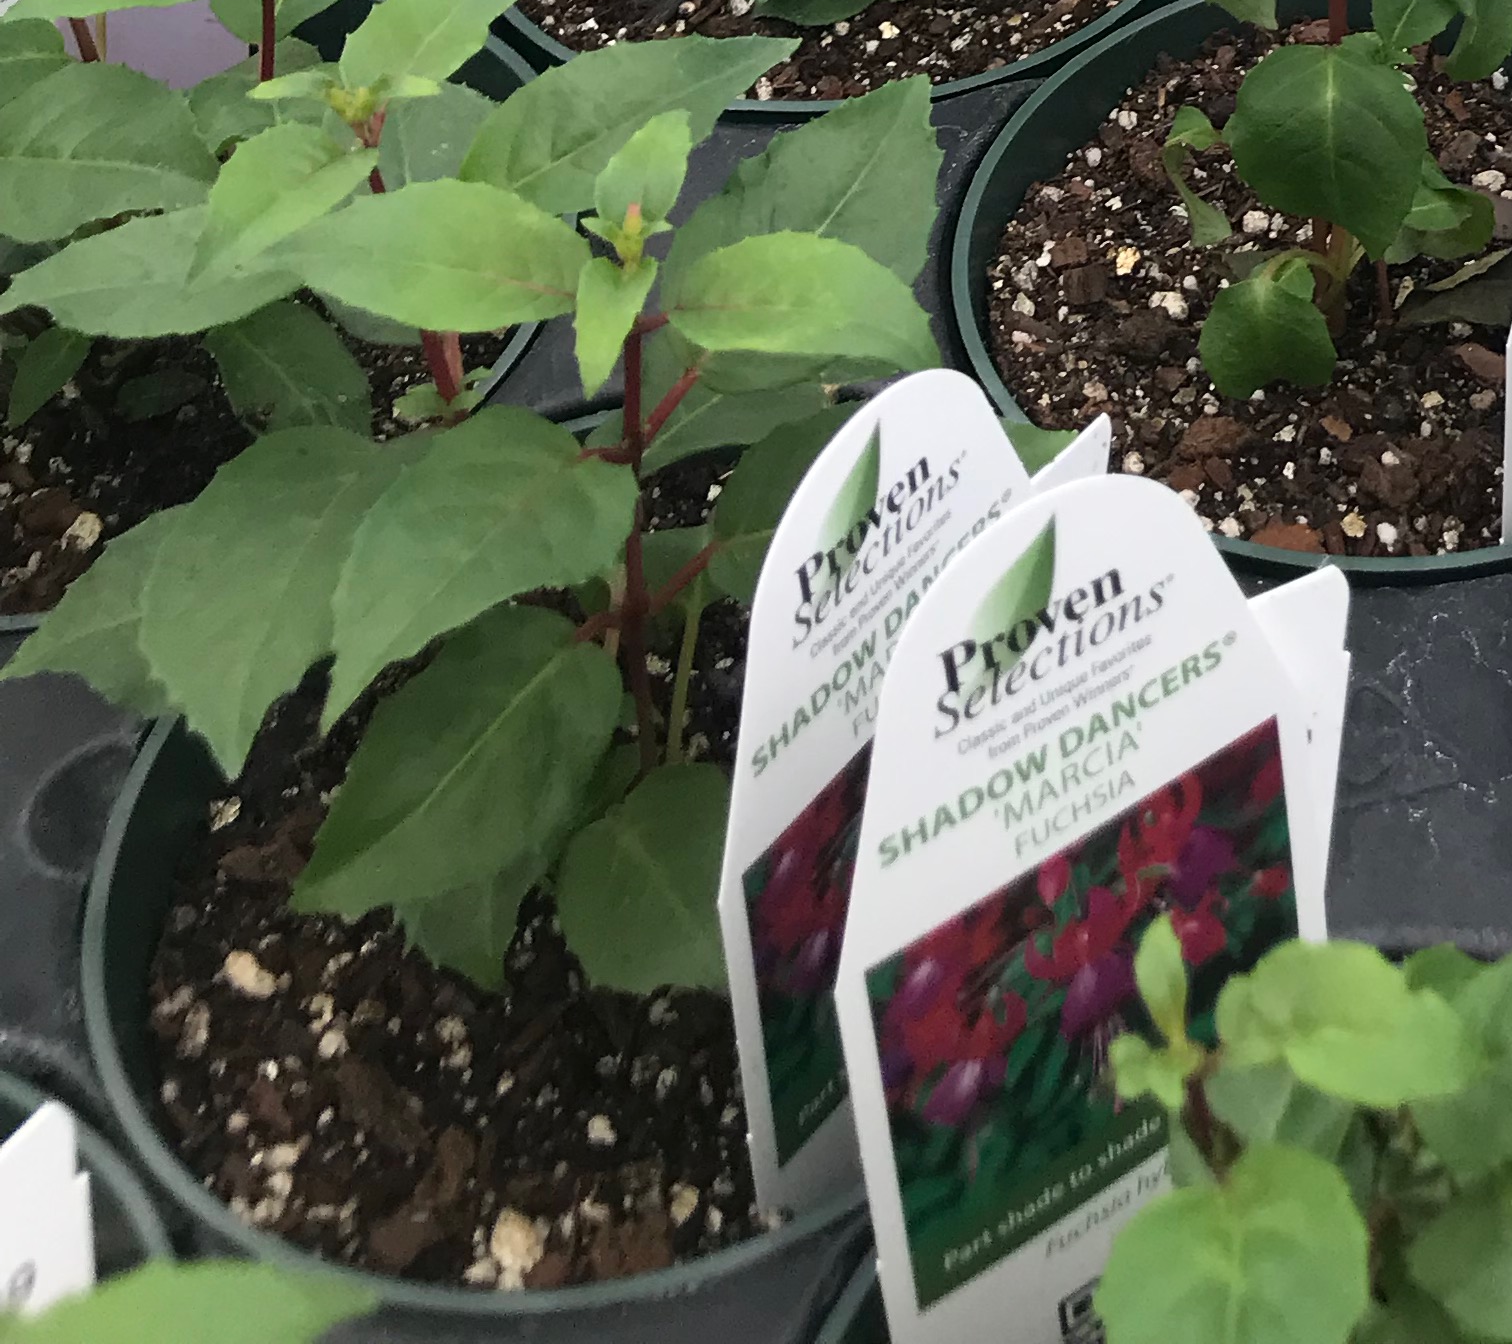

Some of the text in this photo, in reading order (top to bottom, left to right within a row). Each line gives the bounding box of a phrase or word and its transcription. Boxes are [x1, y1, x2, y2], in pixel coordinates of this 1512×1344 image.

[792, 457, 963, 650] Selections
[794, 456, 931, 605] Proven
[935, 577, 1169, 738] Selections
[937, 568, 1125, 692] Proven
[751, 631, 877, 778] SHADOW
[957, 635, 1152, 755] Classic and Unique Favorites
[988, 736, 1020, 759] from
[1023, 706, 1070, 740] Proven
[877, 744, 1048, 867] SHADOW
[994, 721, 1142, 829] 'MARCIA'
[1015, 769, 1136, 859] FUCHSIA
[944, 1230, 992, 1270] Part
[998, 1183, 1065, 1235] shade
[1069, 1164, 1092, 1189] to
[1098, 1116, 1162, 1168] shade
